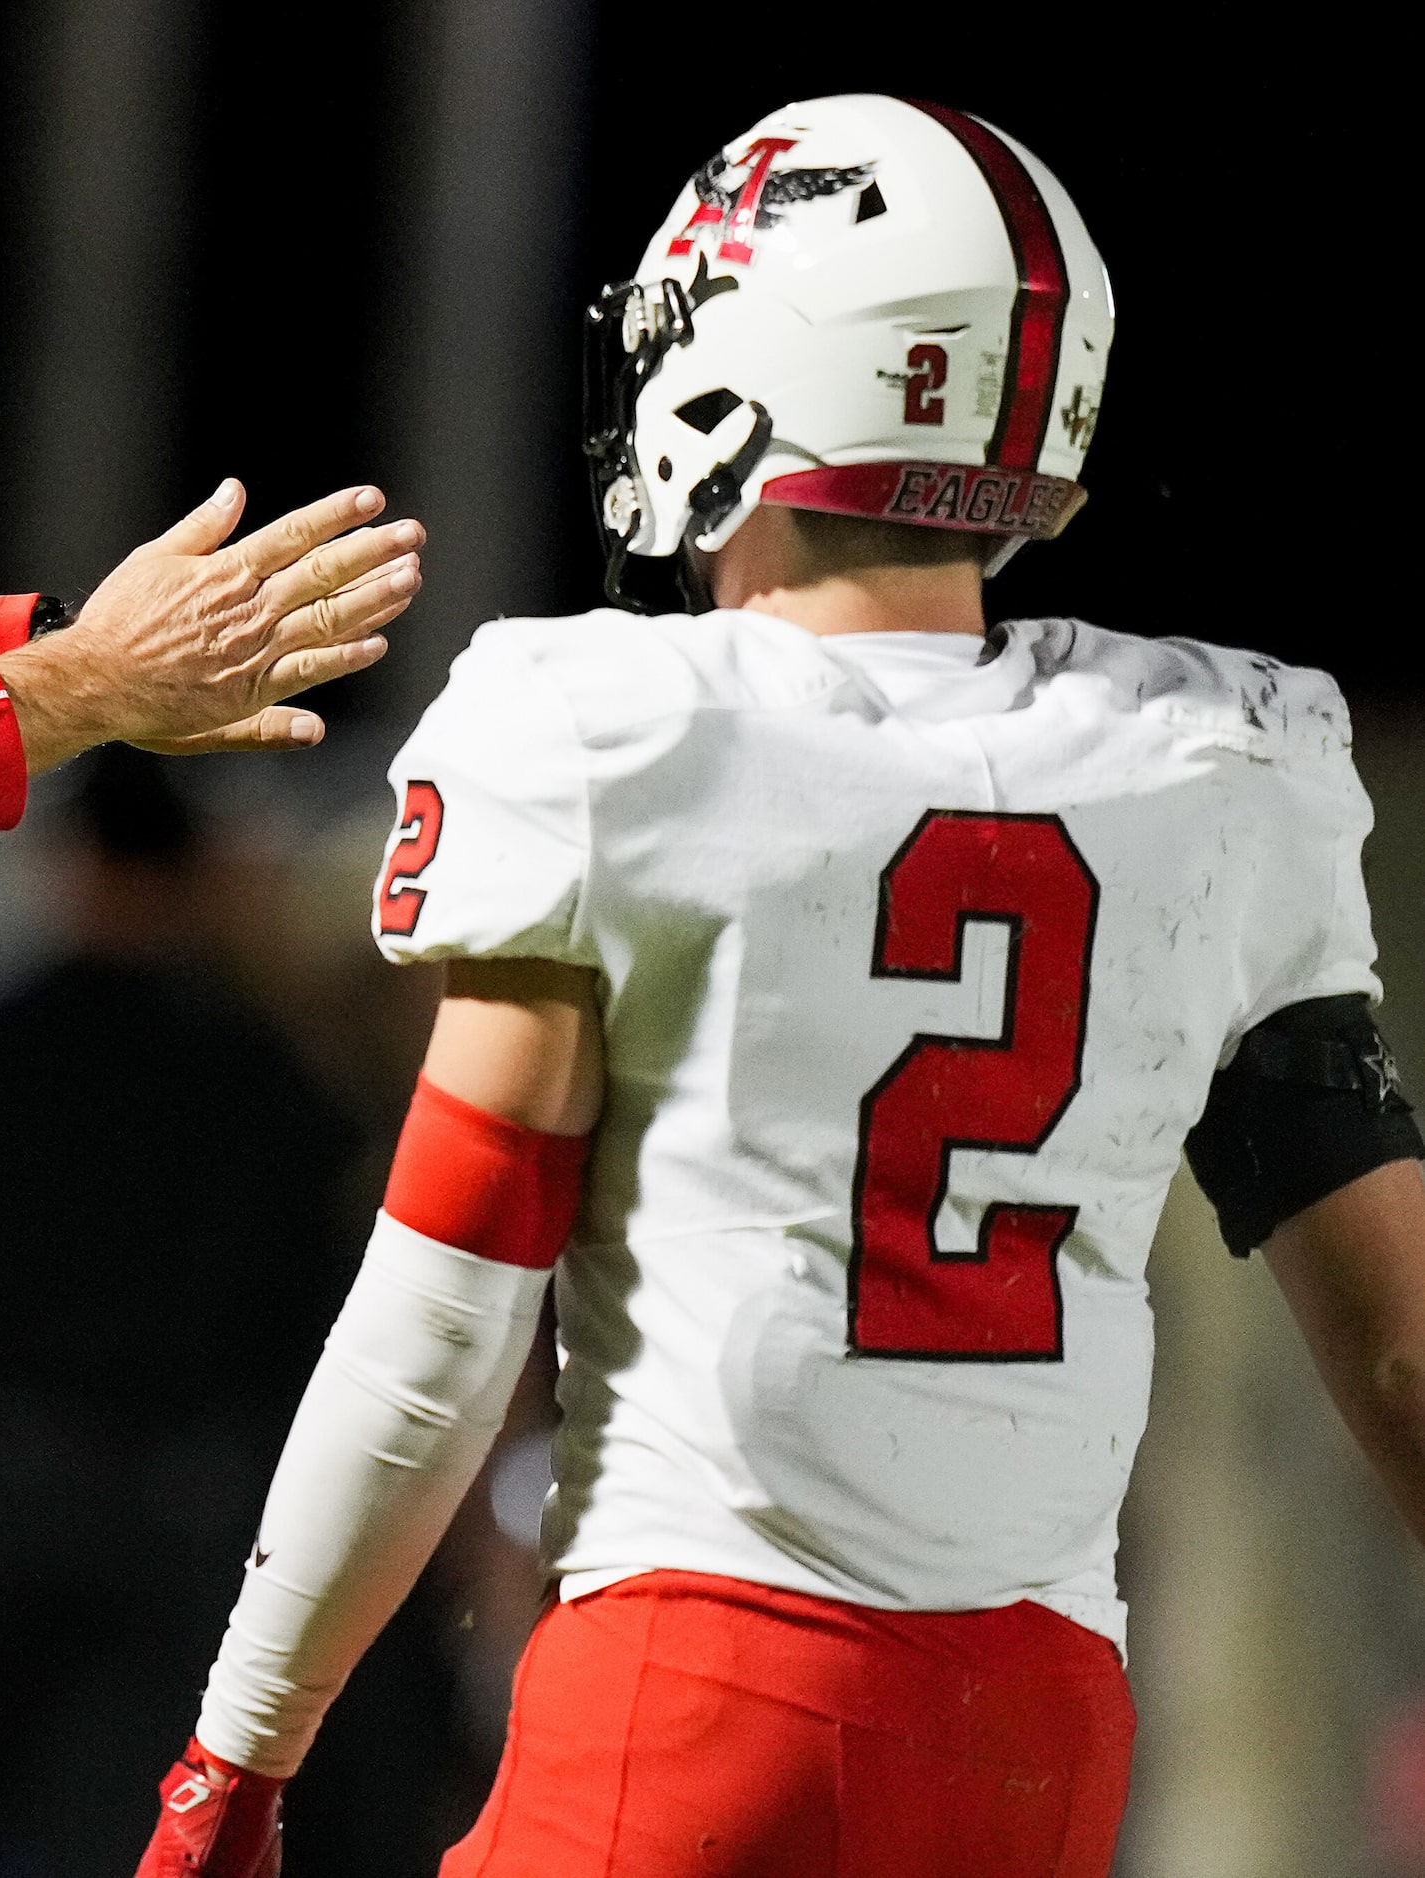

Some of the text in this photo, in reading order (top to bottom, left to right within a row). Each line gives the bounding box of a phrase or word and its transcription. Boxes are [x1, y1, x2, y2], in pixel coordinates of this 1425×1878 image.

[905, 344, 947, 425] 2
[887, 467, 1065, 531] EAGLES
[380, 779, 444, 937] 2
[848, 809, 1100, 1361] 2
